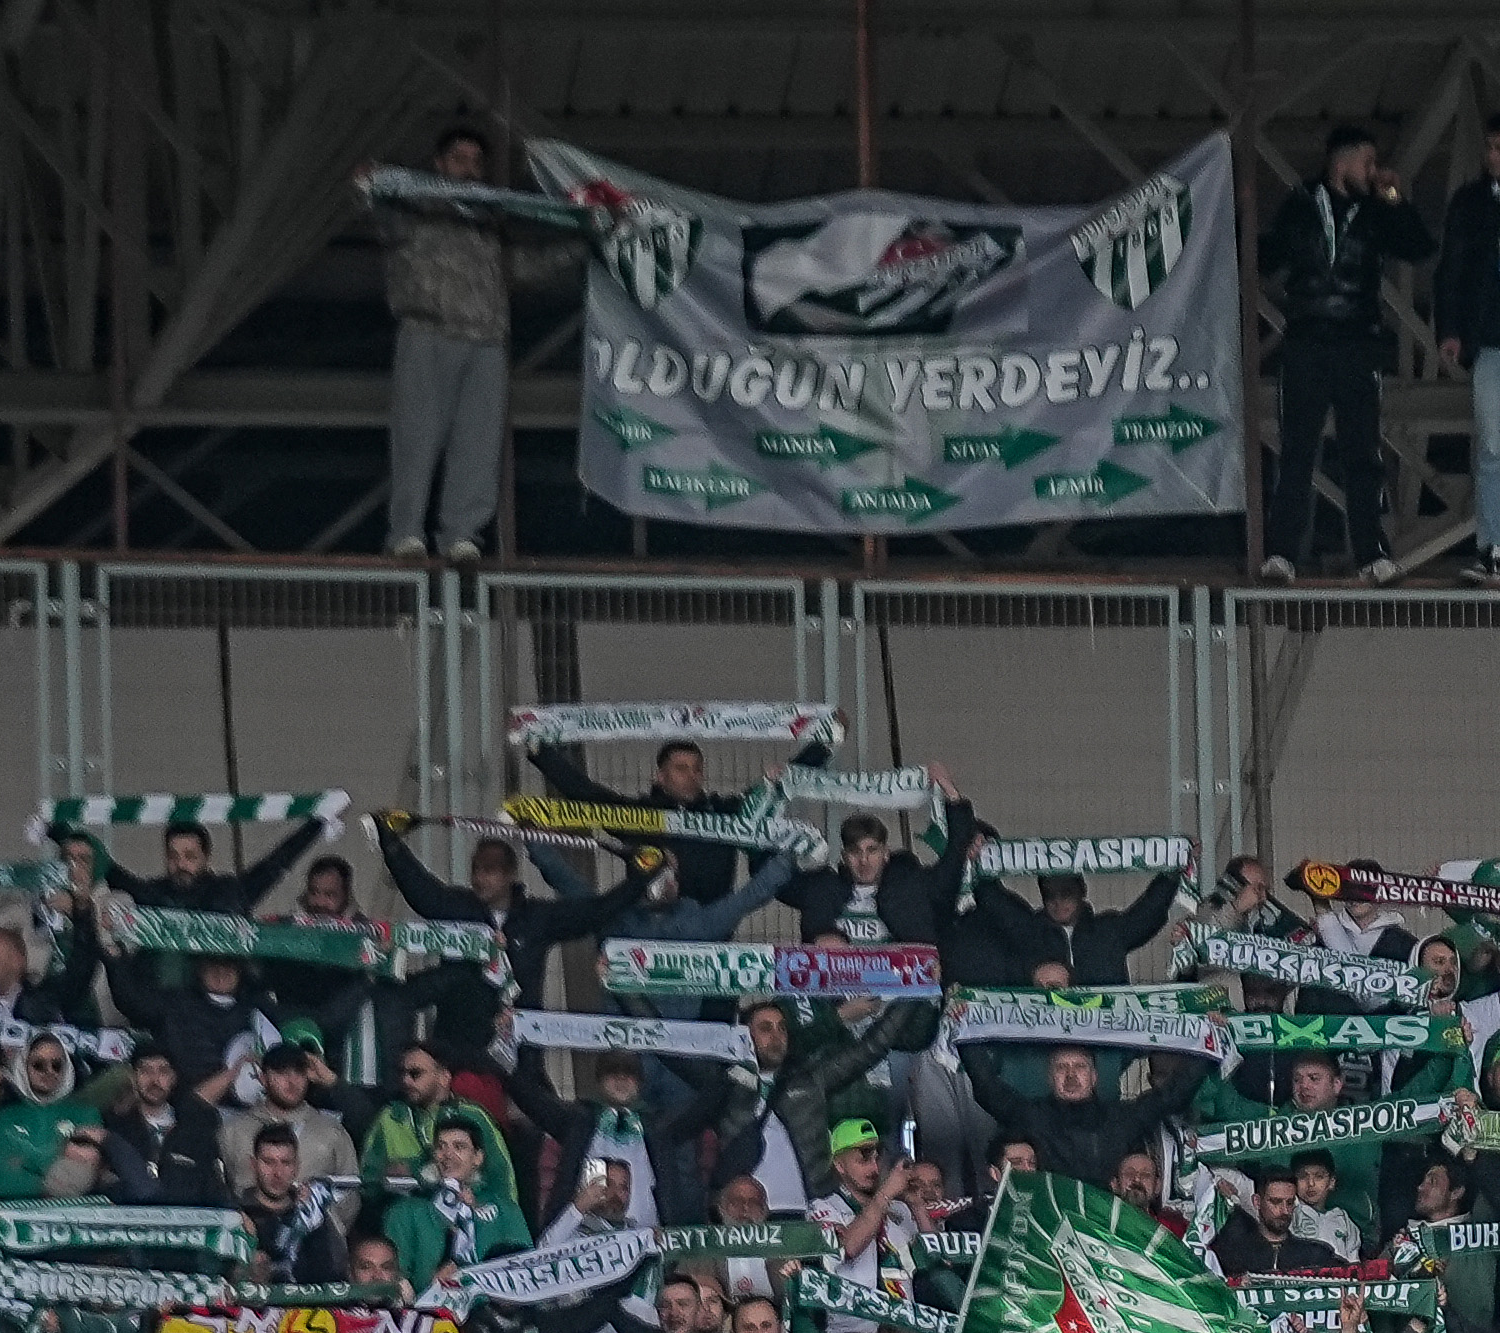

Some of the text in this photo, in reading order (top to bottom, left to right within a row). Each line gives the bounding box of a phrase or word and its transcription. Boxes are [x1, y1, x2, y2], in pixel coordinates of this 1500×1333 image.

[984, 838, 1191, 874] BURSASPOR
[1206, 938, 1422, 1004] BURSASPOR
[1232, 1016, 1430, 1047] EXAS
[1223, 1099, 1417, 1155] BURSASPOR
[714, 1225, 781, 1247] YAVUZ
